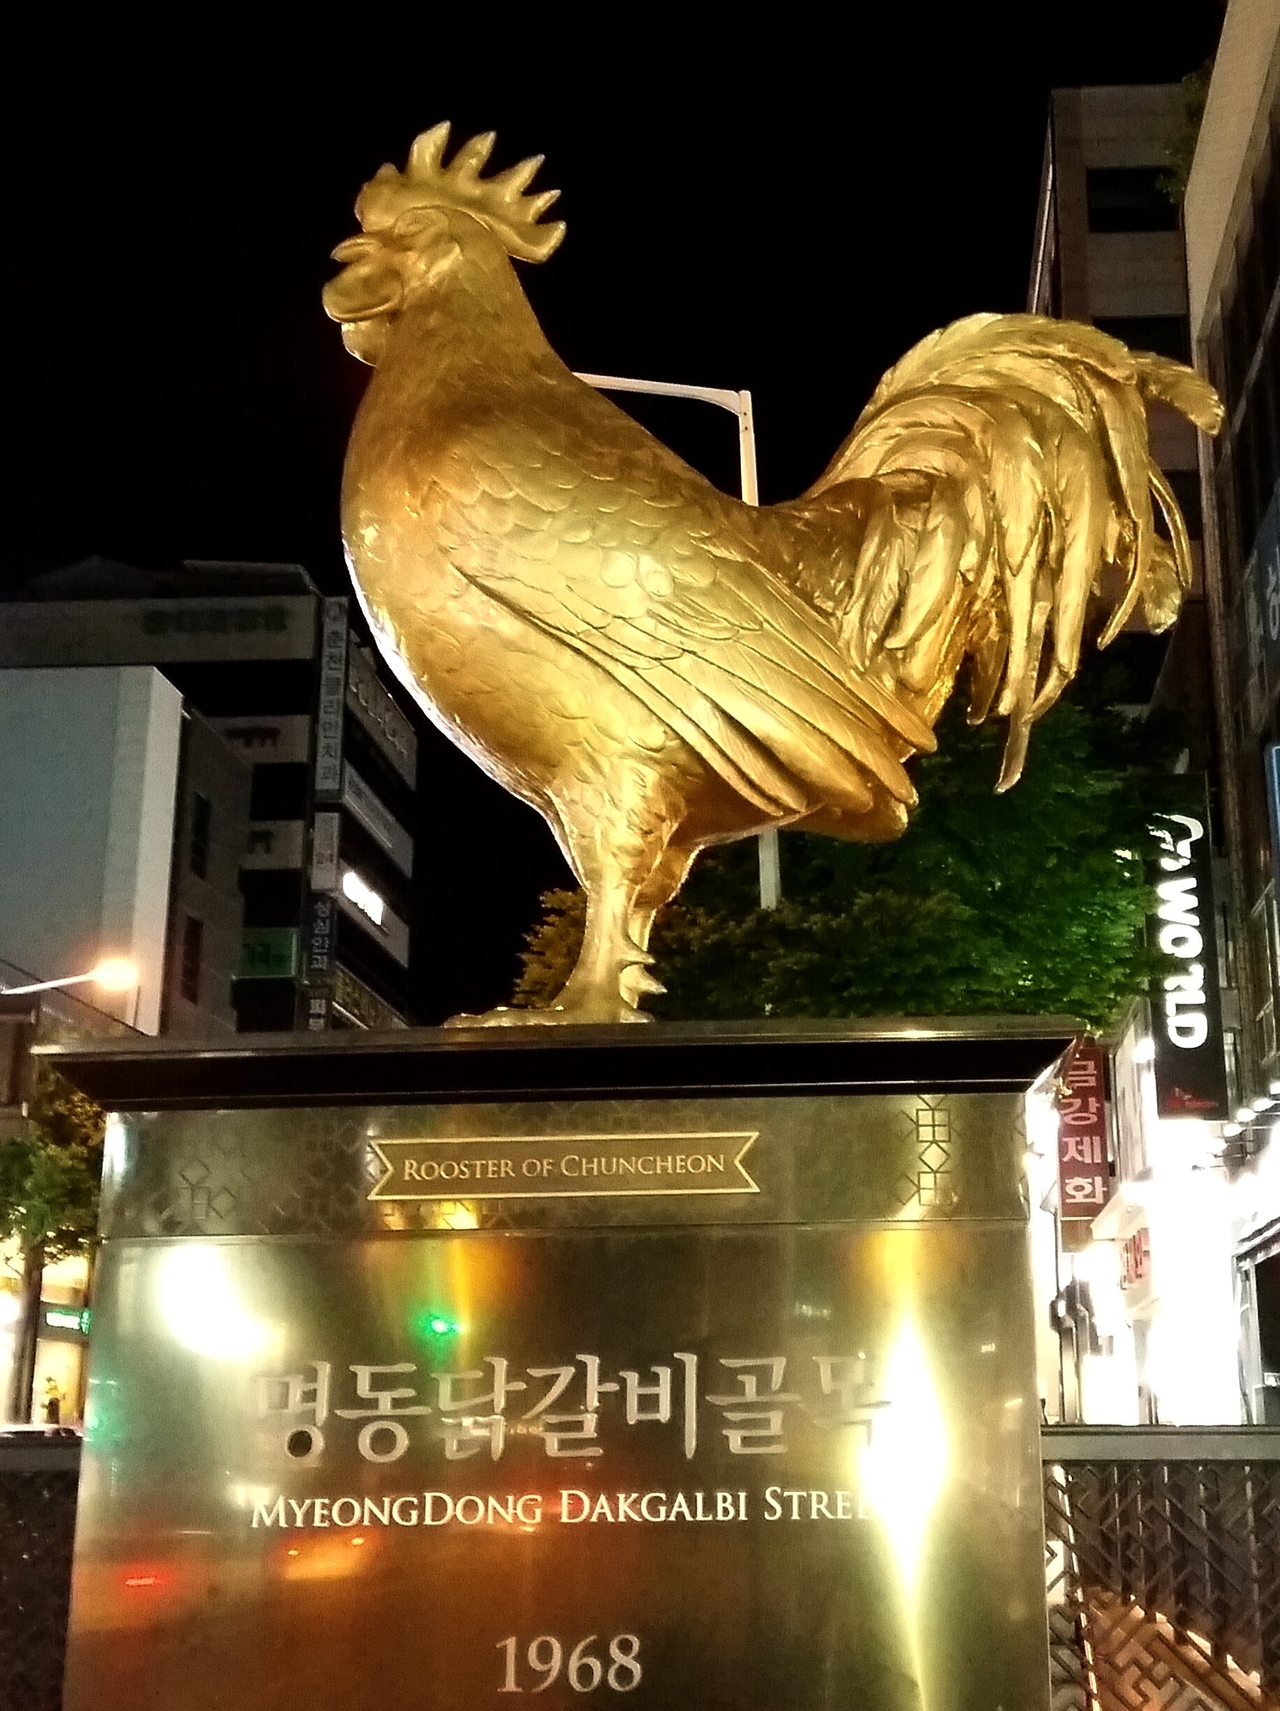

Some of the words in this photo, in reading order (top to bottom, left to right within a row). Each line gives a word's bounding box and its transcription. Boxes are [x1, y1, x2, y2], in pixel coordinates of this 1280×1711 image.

[1157, 877, 1208, 1049] WORLD
[403, 1159, 514, 1181] ROOSTER
[522, 1158, 553, 1177] OF
[560, 1153, 725, 1176] CHUNCHEON
[1060, 1061, 1107, 1204] 금강제화
[256, 1352, 893, 1465] 명동닭갈비골목
[560, 1489, 748, 1523] DAKGALBI
[764, 1486, 876, 1520] STREE
[496, 1634, 642, 1692] 1968
